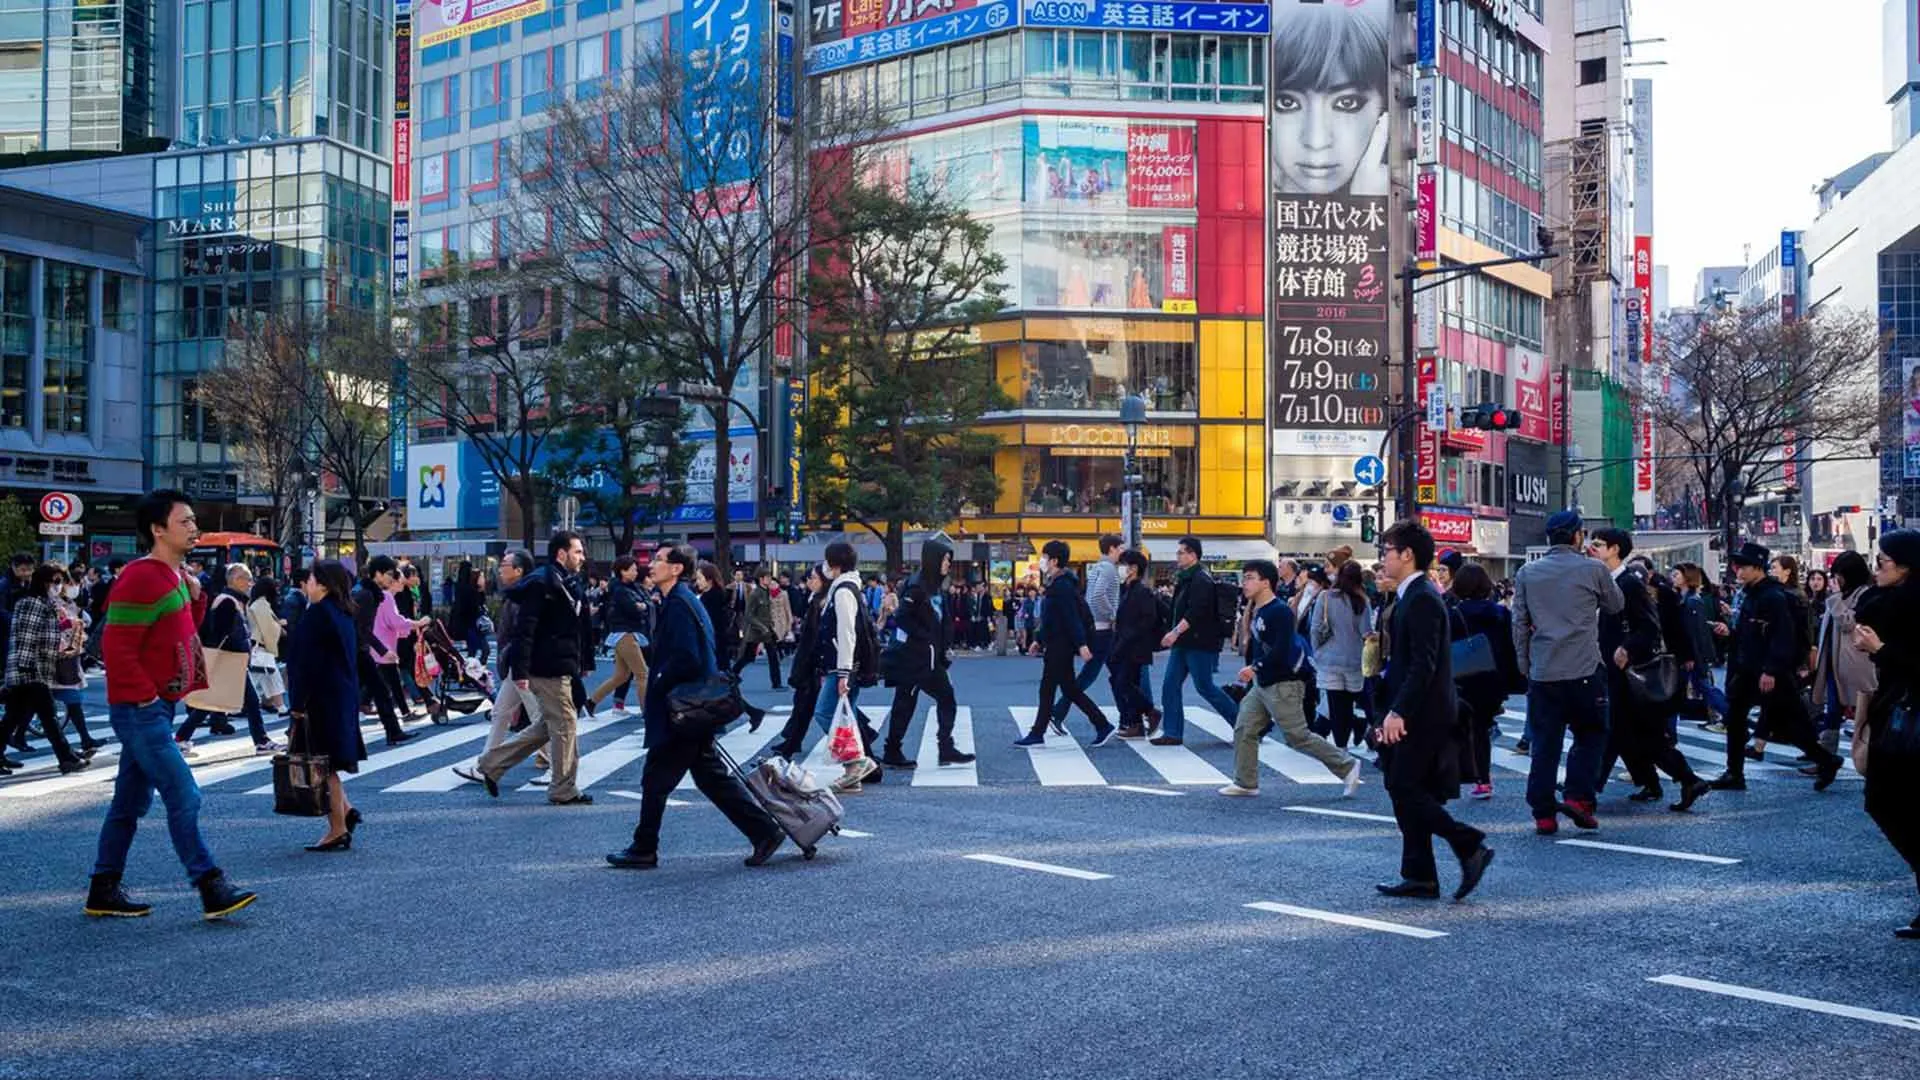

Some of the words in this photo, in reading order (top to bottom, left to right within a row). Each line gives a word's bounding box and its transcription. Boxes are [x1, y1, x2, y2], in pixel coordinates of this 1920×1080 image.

[813, 5, 841, 31] 7F
[1034, 4, 1086, 19] AEON
[1103, 4, 1265, 29] 英会話イーオン
[859, 14, 979, 58] 英会話イーオン
[1130, 132, 1169, 153] 沖縄
[168, 216, 240, 235] MARK
[1277, 200, 1385, 231] 国立代々木
[1277, 233, 1387, 265] 競技場第一
[1278, 267, 1347, 297] 体育館
[1358, 264, 1376, 288] 3
[1317, 307, 1347, 318] 2016
[1283, 326, 1379, 357] 7月8日(金)
[1283, 360, 1379, 391] 7月9日(土)
[1279, 394, 1384, 425] 7月10日(日)
[1051, 424, 1169, 447] L'OCCITNE
[1515, 473, 1548, 505] LUSH
